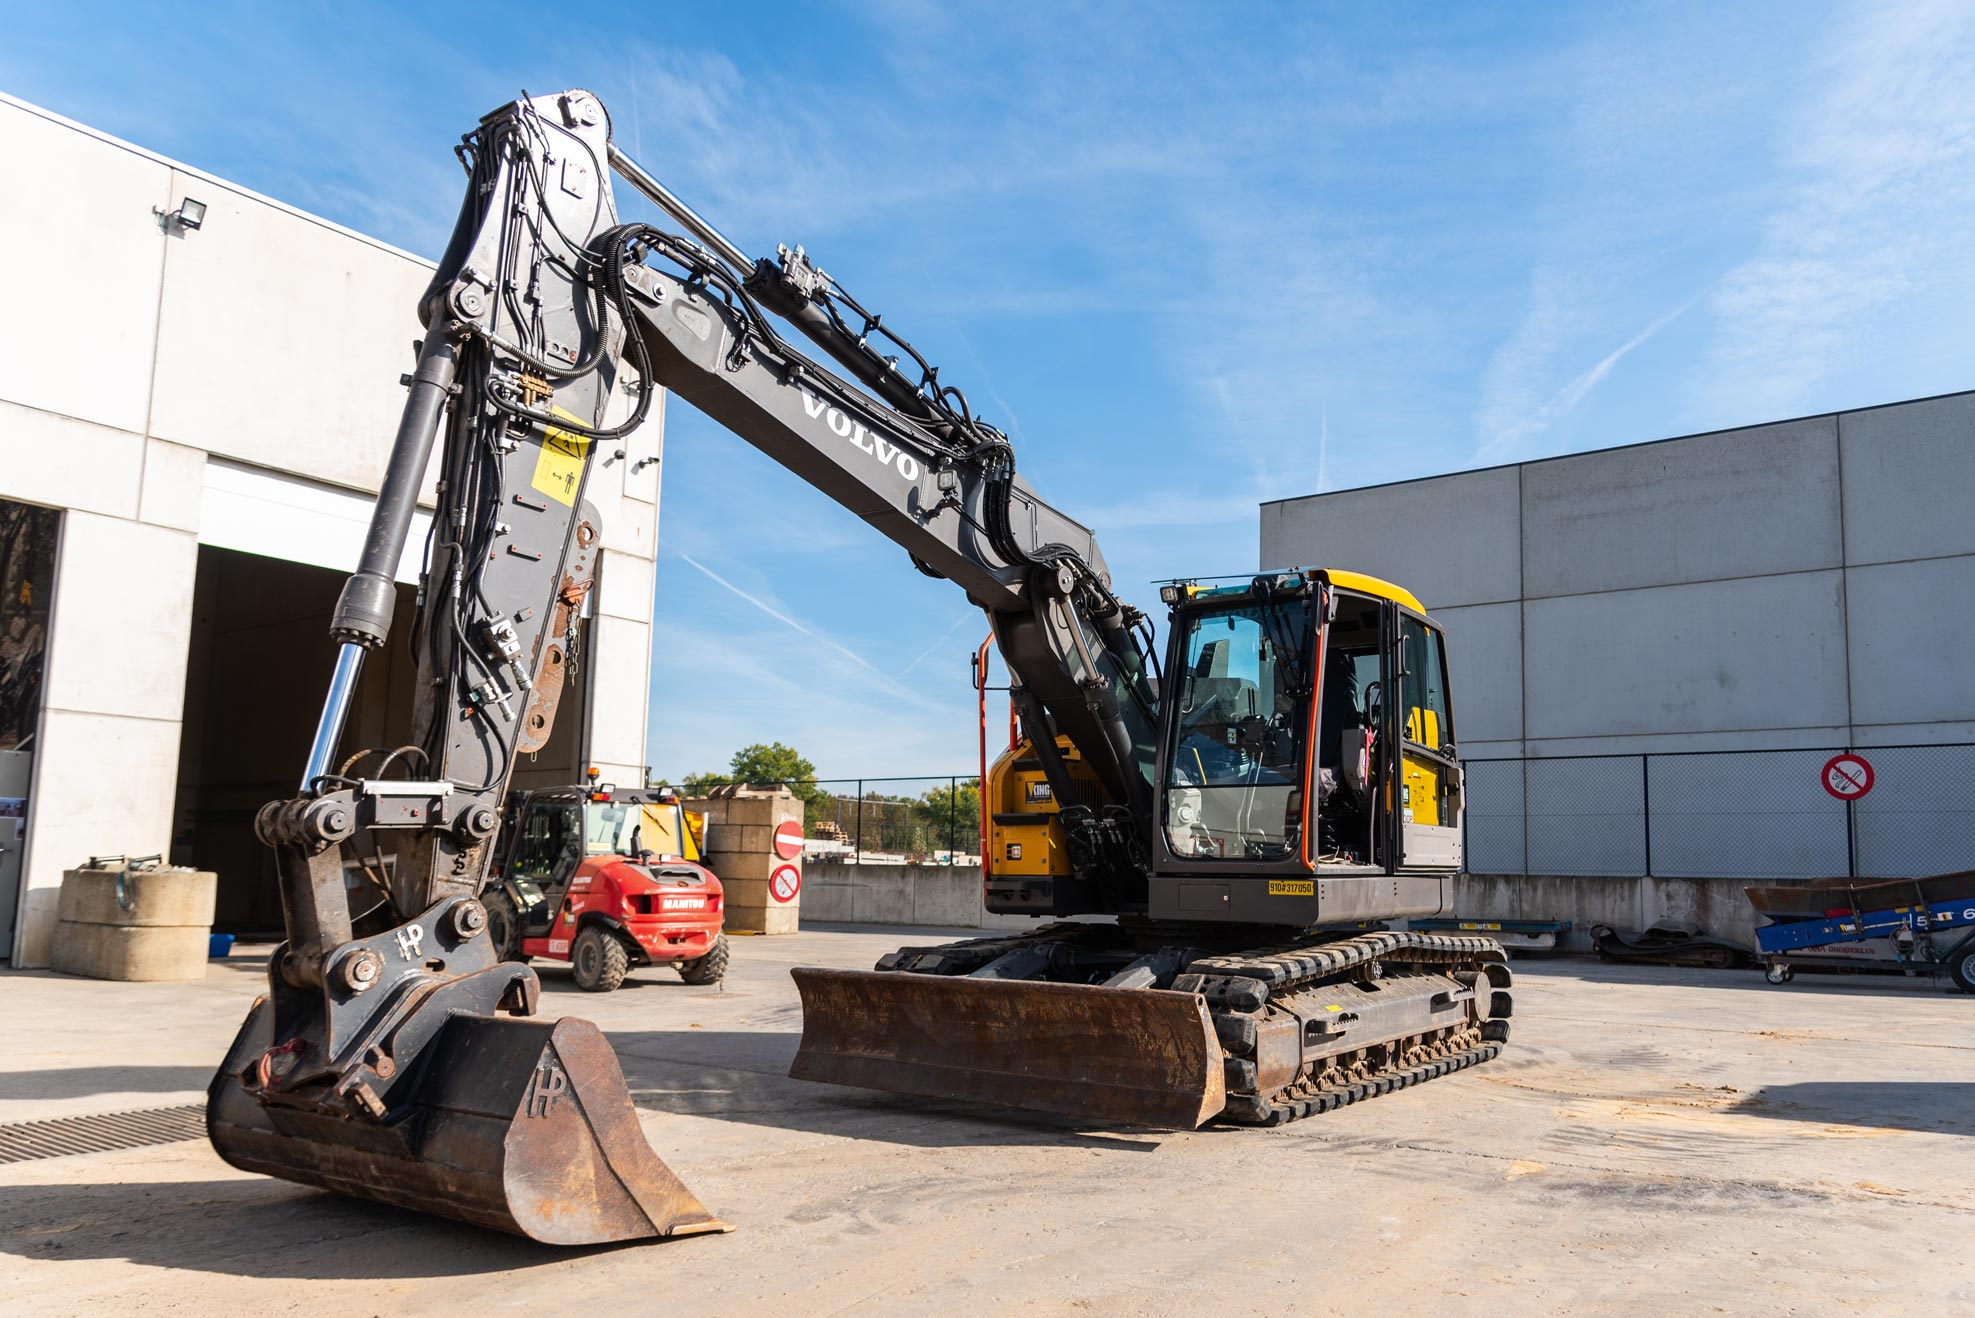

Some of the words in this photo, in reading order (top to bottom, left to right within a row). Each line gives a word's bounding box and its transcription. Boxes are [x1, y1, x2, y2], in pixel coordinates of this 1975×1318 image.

[798, 382, 919, 481] VOLVO
[663, 899, 705, 910] MANITOU
[1917, 916, 1928, 927] 5
[1963, 908, 1975, 920] 6
[528, 1065, 567, 1119] HP
